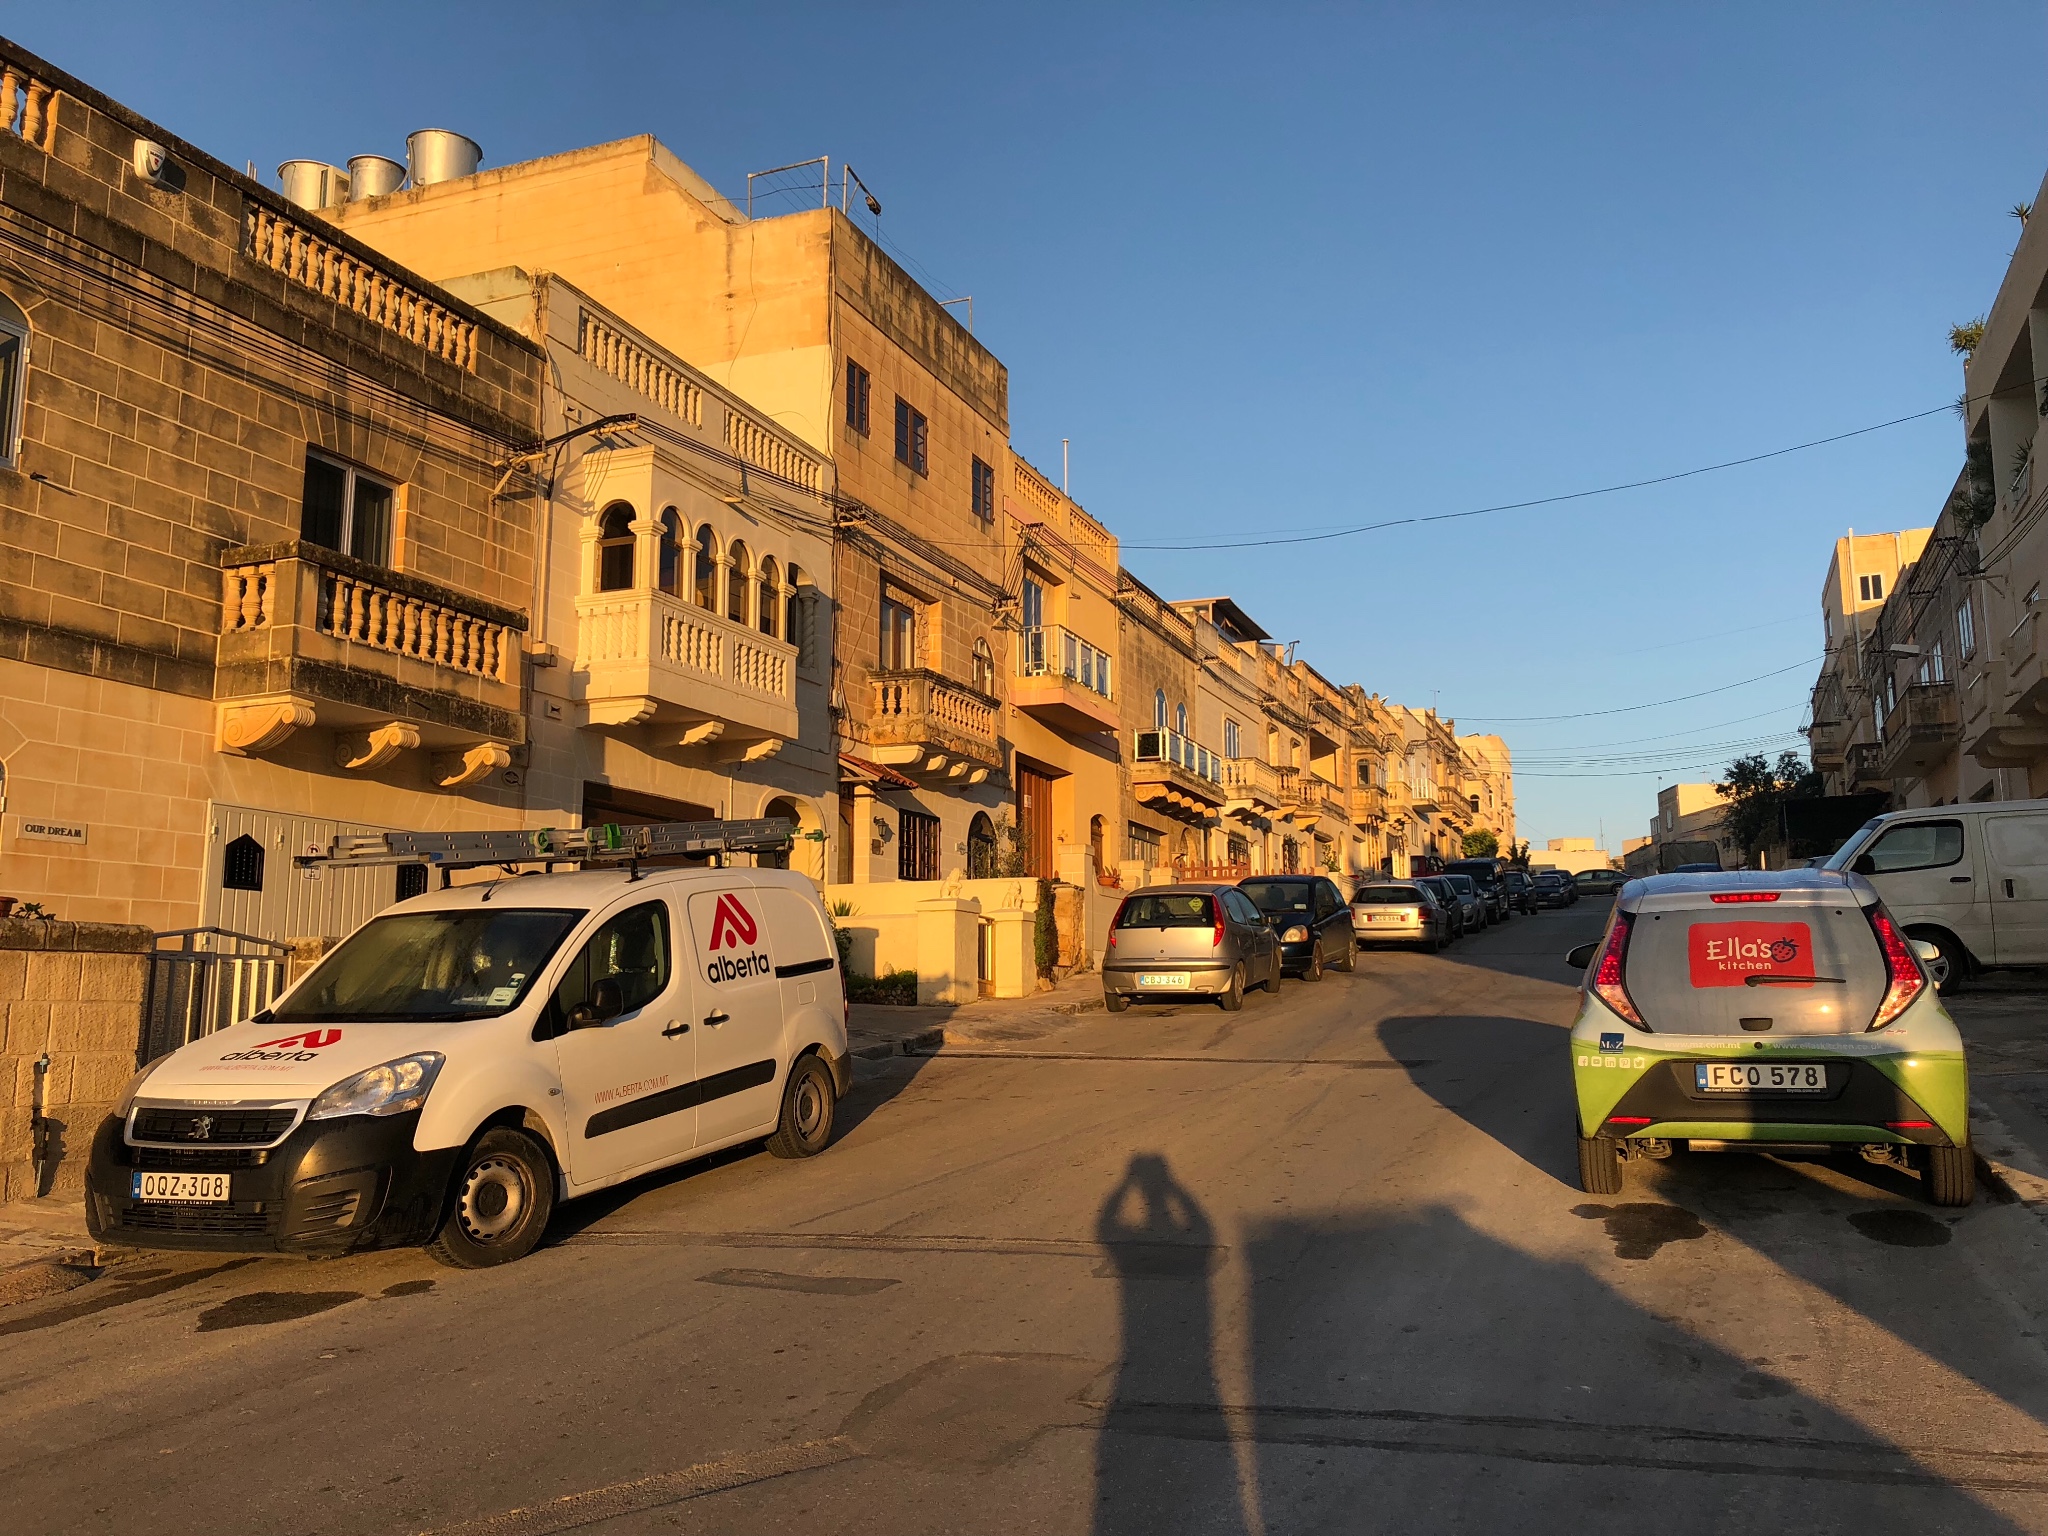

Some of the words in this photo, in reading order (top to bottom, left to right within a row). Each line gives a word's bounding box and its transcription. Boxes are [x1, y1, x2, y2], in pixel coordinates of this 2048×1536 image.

[24, 823, 46, 834] OUR
[47, 826, 82, 838] DREAM
[1706, 936, 1771, 961] Ella's
[707, 950, 771, 984] alberta
[1718, 960, 1772, 971] kitchen
[1663, 1041, 1741, 1049] www.mz.com.mt
[219, 1049, 320, 1062] alberta
[1770, 1066, 1818, 1087] 578
[594, 1074, 669, 1105] WWW.ALBERTA.COM.MT
